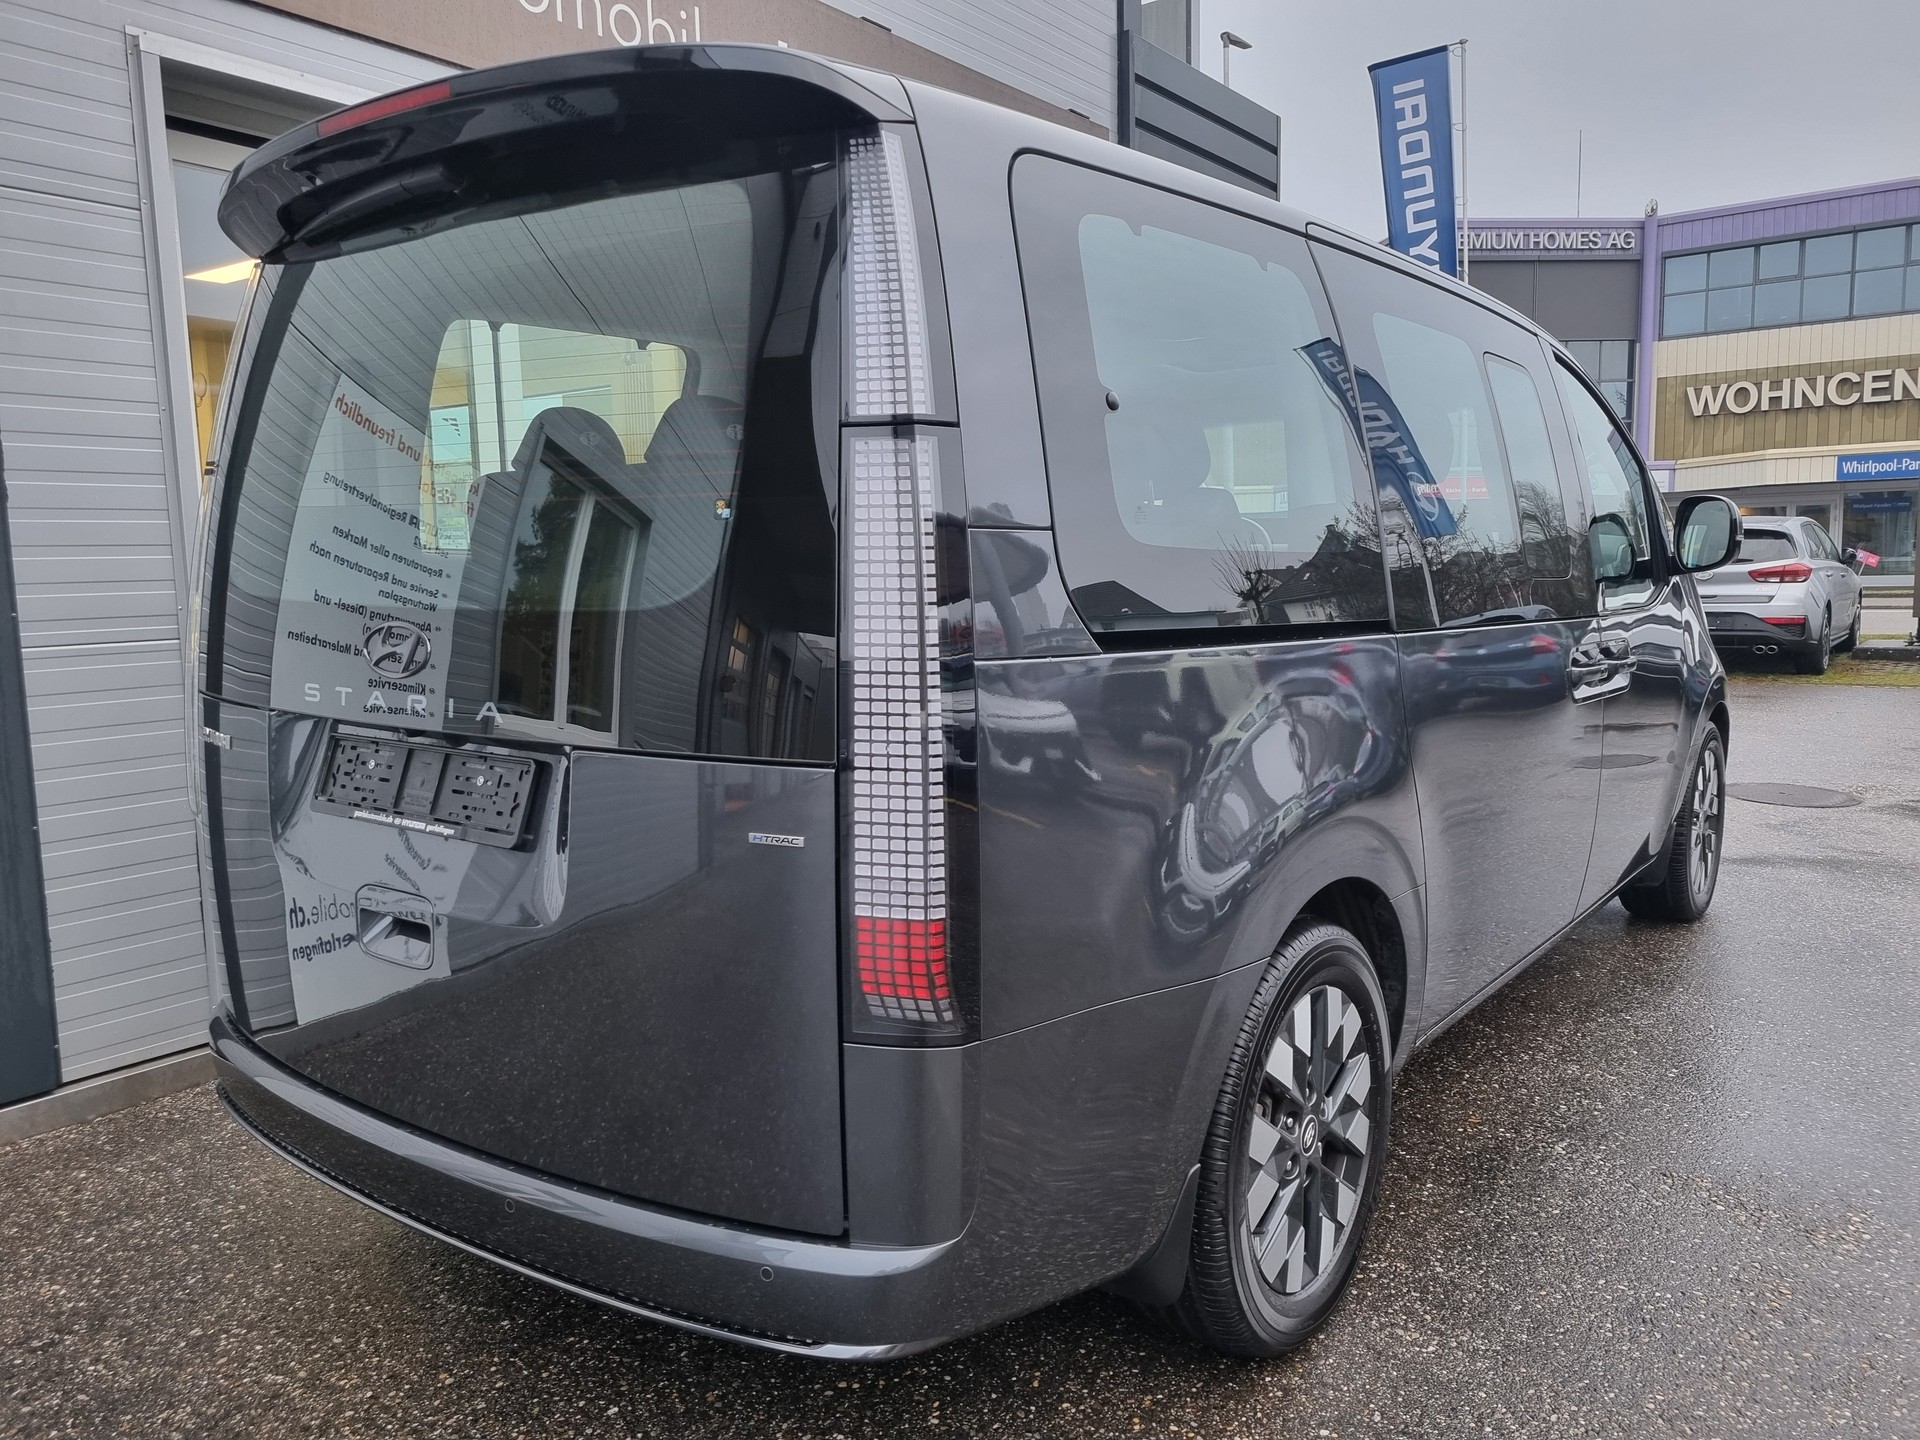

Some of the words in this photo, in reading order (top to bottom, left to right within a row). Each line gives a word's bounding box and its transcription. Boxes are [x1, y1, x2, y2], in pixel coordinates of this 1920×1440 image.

[1530, 231, 1602, 249] HOMES
[1606, 231, 1635, 249] AG
[1687, 368, 1920, 417] WOHNCEN
[304, 683, 504, 724] STARIA
[753, 835, 799, 845] HTRAC
